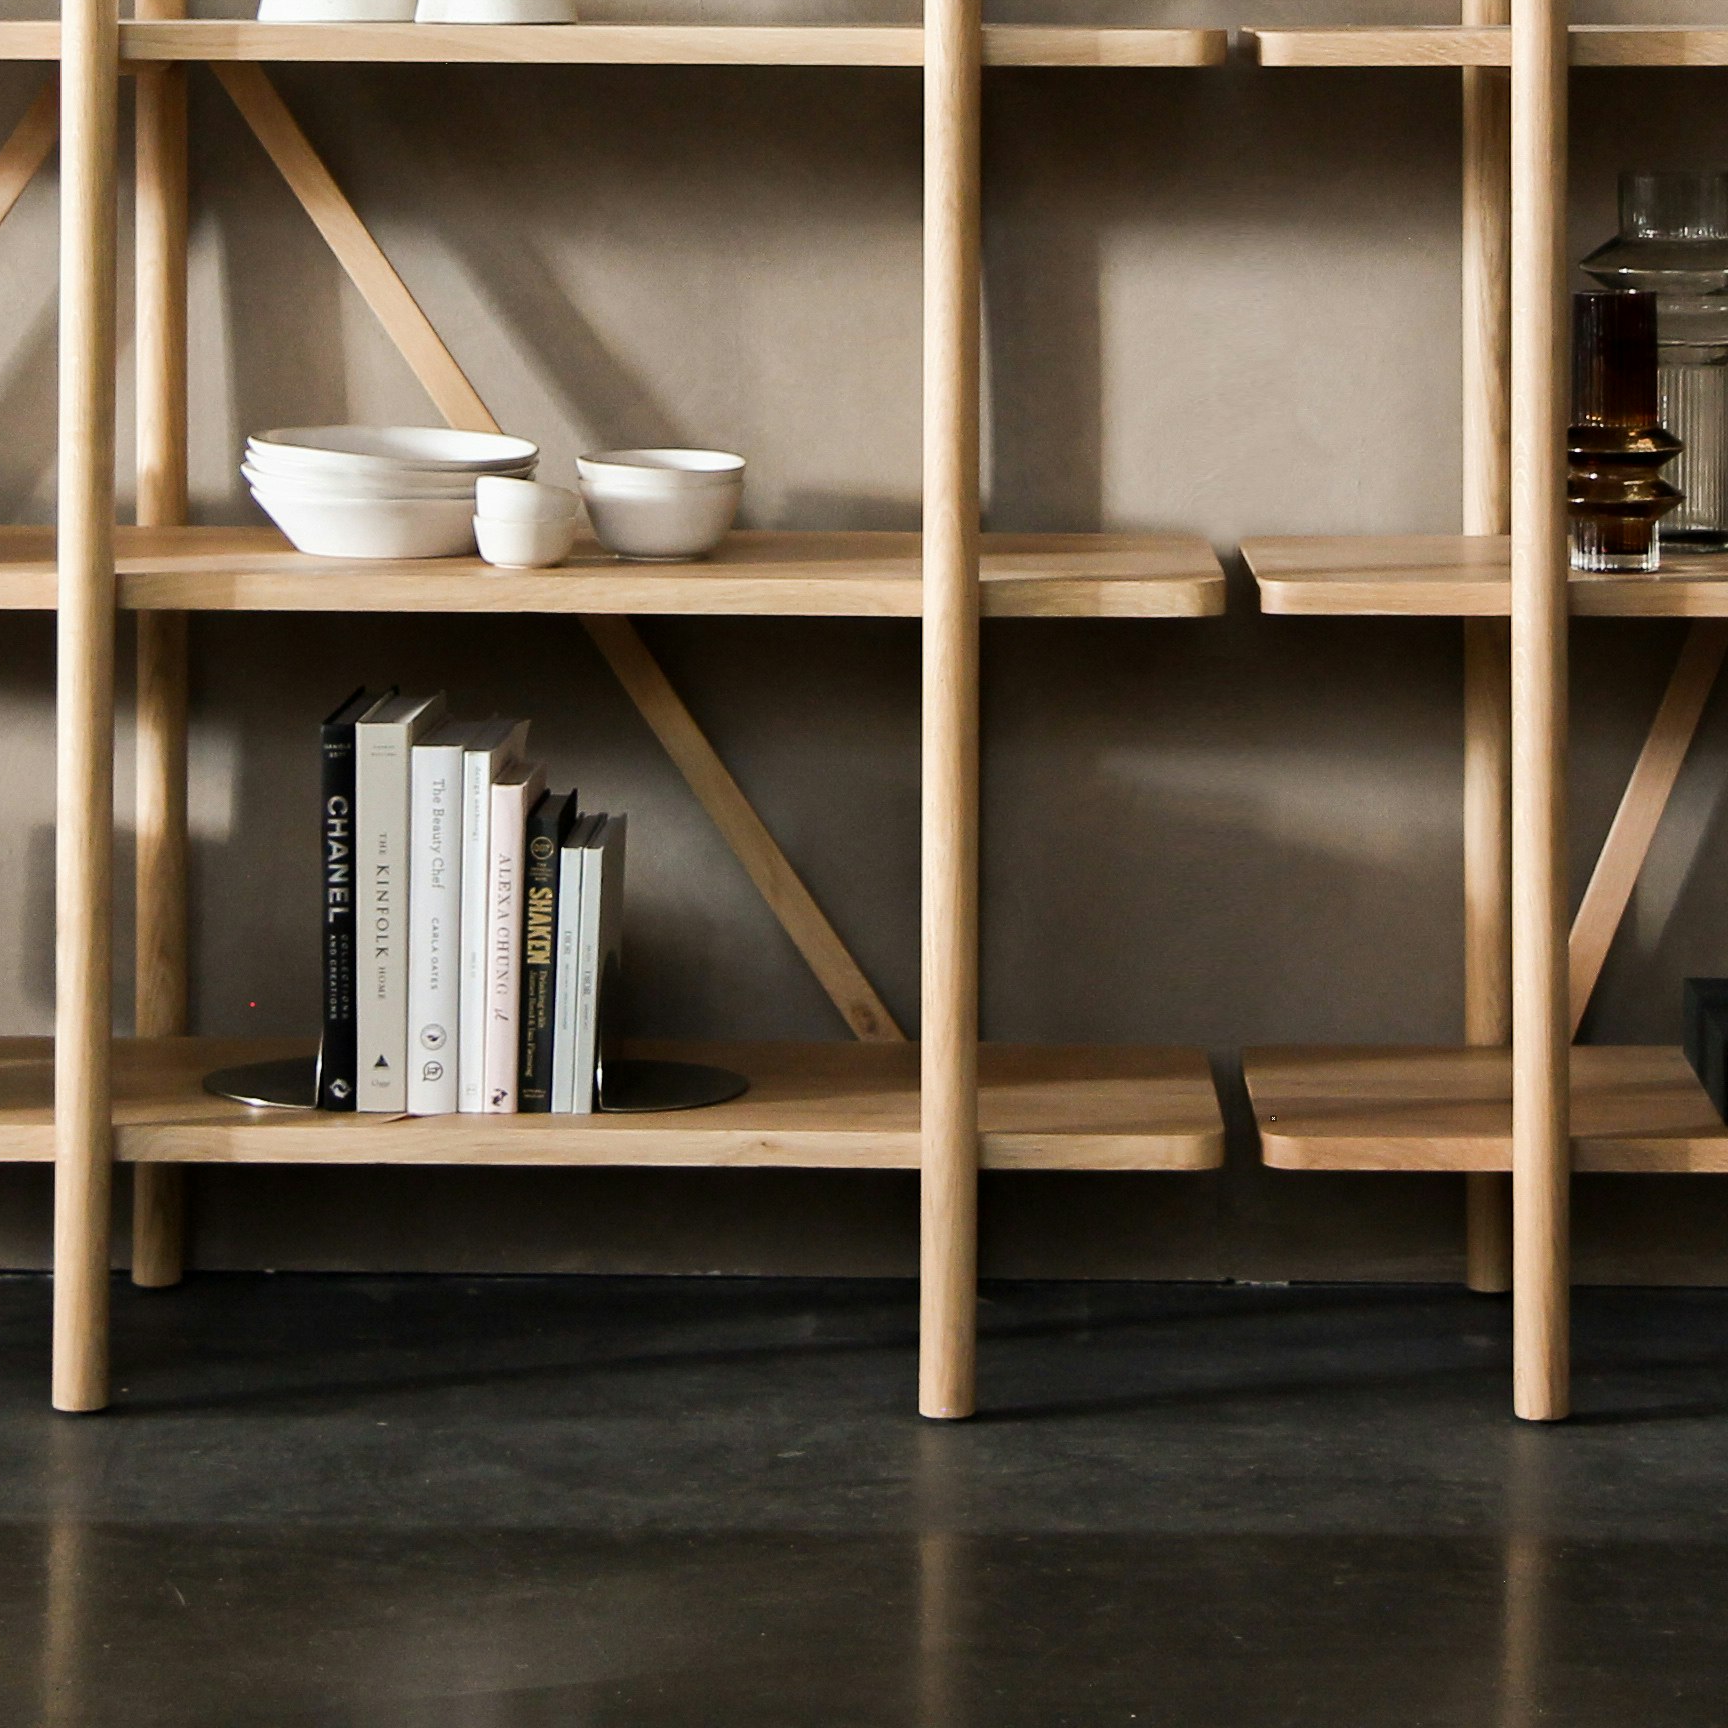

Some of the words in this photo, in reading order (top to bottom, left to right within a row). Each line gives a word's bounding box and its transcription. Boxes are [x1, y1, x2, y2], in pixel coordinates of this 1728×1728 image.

[432, 779, 445, 804] The
[378, 833, 388, 856] THE
[429, 808, 445, 854] Beauty
[327, 795, 349, 923] CHANEL
[430, 857, 445, 890] Chef
[497, 853, 512, 920] ALEXA
[375, 865, 390, 960] KINFOLK
[431, 917, 440, 952] CARLA
[527, 887, 552, 964] SHAKEN
[328, 934, 338, 957] AND
[495, 927, 511, 995] CHUNG
[328, 960, 338, 1021] CREATIONS
[340, 934, 349, 1021] COLLECTIONS
[376, 966, 387, 1001] HOME
[430, 957, 439, 990] OATES
